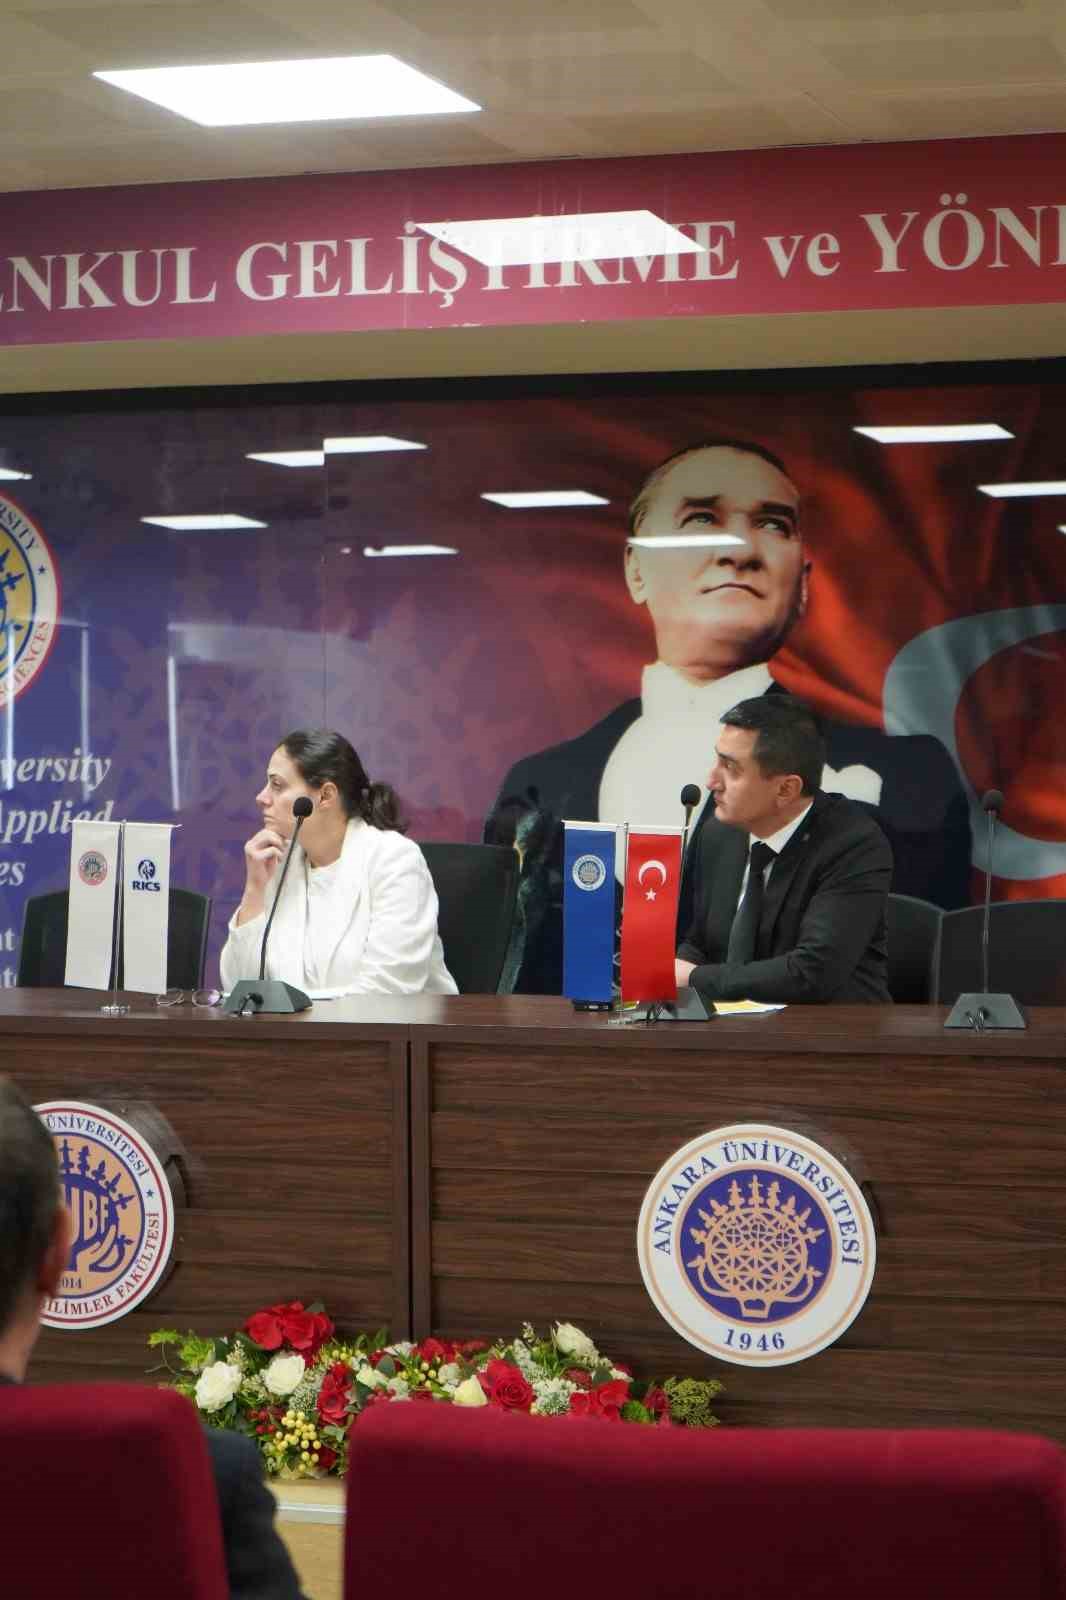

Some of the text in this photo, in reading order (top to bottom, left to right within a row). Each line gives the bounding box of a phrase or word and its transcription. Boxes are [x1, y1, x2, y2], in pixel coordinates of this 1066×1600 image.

[0, 247, 217, 312] NKUL
[763, 232, 841, 279] ve
[0, 800, 114, 844] pplid
[132, 881, 160, 892] RICS
[654, 1140, 863, 1265] ANKARA ÜNİVERSİTESİ
[118, 1212, 160, 1297] FAKÜLTESİ
[724, 1328, 785, 1351] 1946
